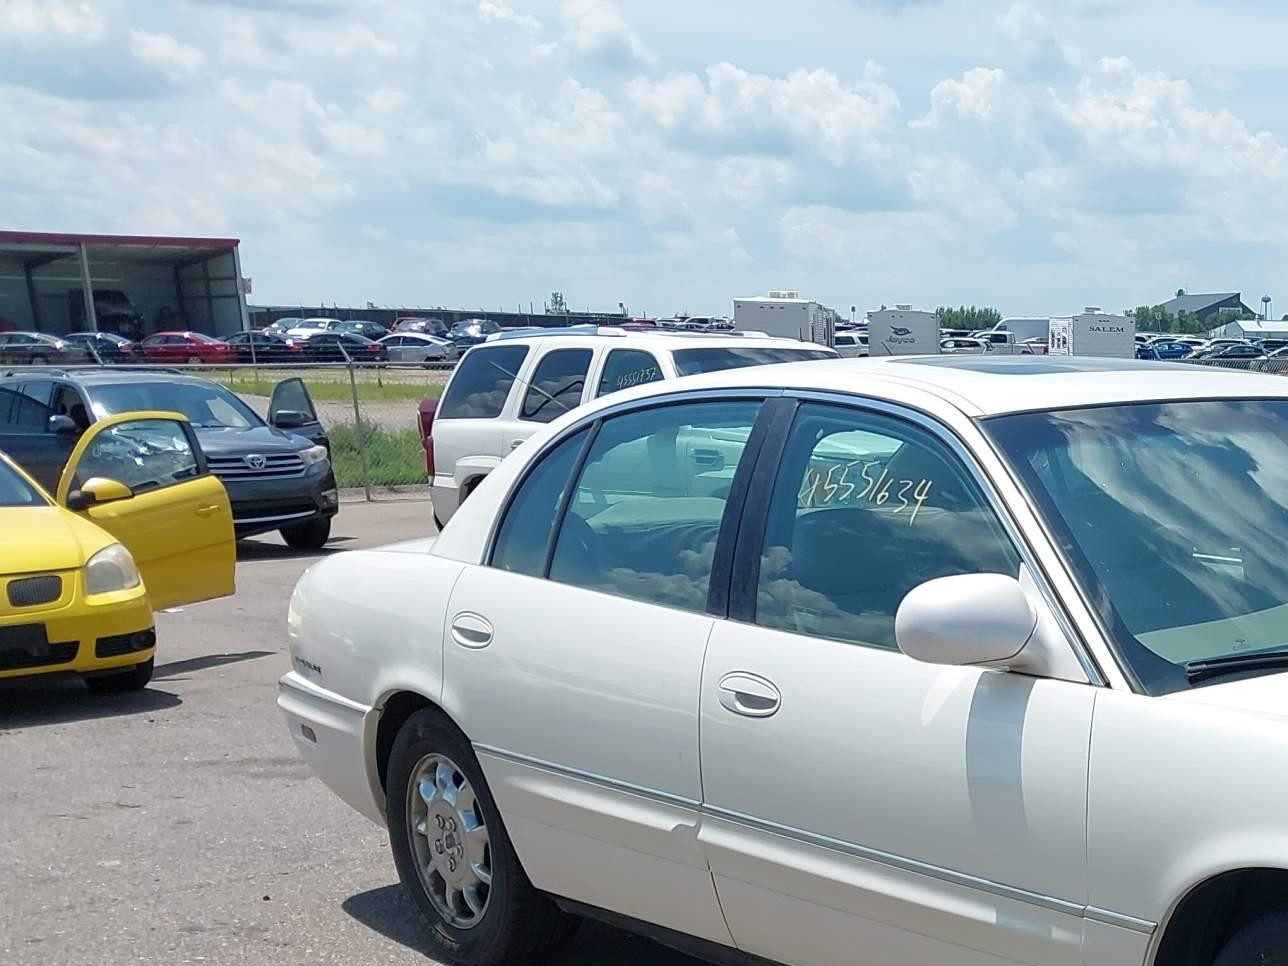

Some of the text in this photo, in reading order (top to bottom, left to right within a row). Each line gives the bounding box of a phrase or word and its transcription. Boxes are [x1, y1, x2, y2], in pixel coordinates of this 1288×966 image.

[1089, 325, 1124, 333] SALEM
[885, 335, 916, 345] Jayco
[798, 460, 933, 527] 45551634
